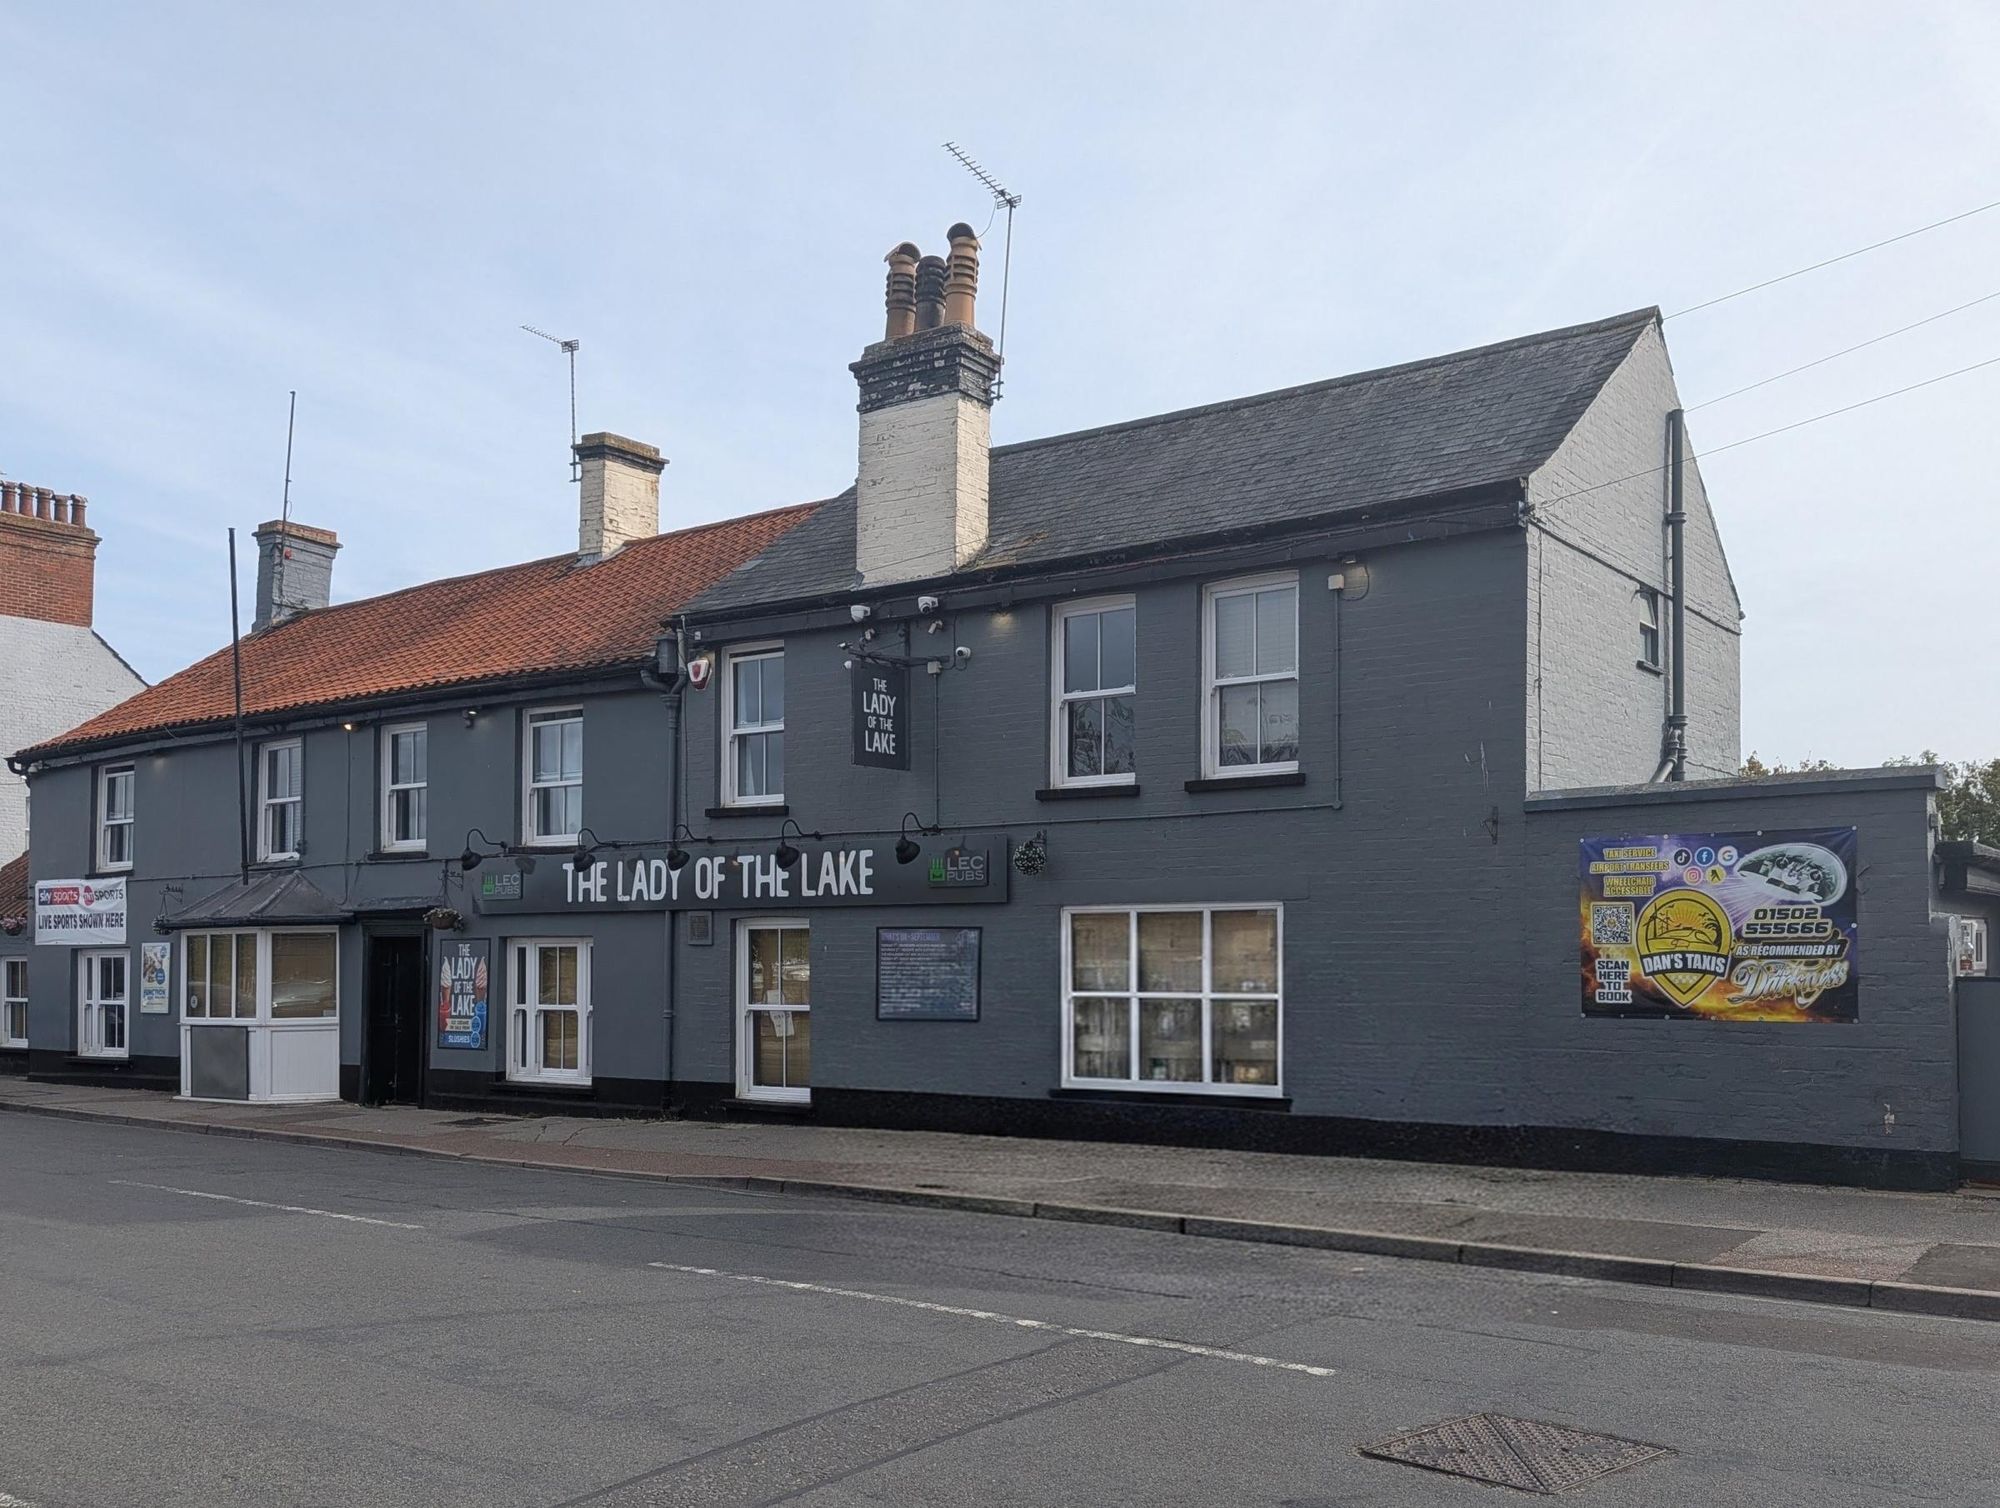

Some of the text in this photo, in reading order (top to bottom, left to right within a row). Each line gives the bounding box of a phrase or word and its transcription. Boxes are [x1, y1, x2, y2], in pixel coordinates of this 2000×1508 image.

[873, 678, 887, 692] THE
[863, 691, 896, 717] LADY
[868, 716, 893, 731] OF THE
[865, 730, 896, 755] LAKE
[1605, 848, 1655, 858] TAXI SERVICE
[947, 855, 984, 870] LEC
[1591, 861, 1669, 873] AIRPORT TRANSFERS
[495, 874, 520, 886] LEC
[562, 850, 873, 903] THE LADY OF THE LAKE
[947, 870, 984, 881] PUBS
[1606, 876, 1654, 886] WHEELCHAIR
[40, 889, 78, 904] sky sports
[94, 889, 124, 901] SPORTS
[495, 886, 520, 895] PUBS
[1606, 886, 1652, 896] ACCESSIBLE
[1754, 908, 1819, 920] 01502
[39, 912, 124, 929] LIVE SPORTS SHOWN HERE
[1745, 922, 1829, 934] 555666
[458, 944, 470, 956] THE
[1736, 944, 1840, 956] AS RECOMMENDED BY
[451, 957, 477, 979] LADY
[1597, 961, 1629, 970] SCAN
[1643, 953, 1725, 973] DAN'S TAXIS
[1599, 971, 1628, 980] HERE
[454, 981, 473, 993] OF THE
[1606, 981, 1621, 990] TO
[1598, 991, 1631, 1001] BOOK
[451, 994, 475, 1016] LAKE
